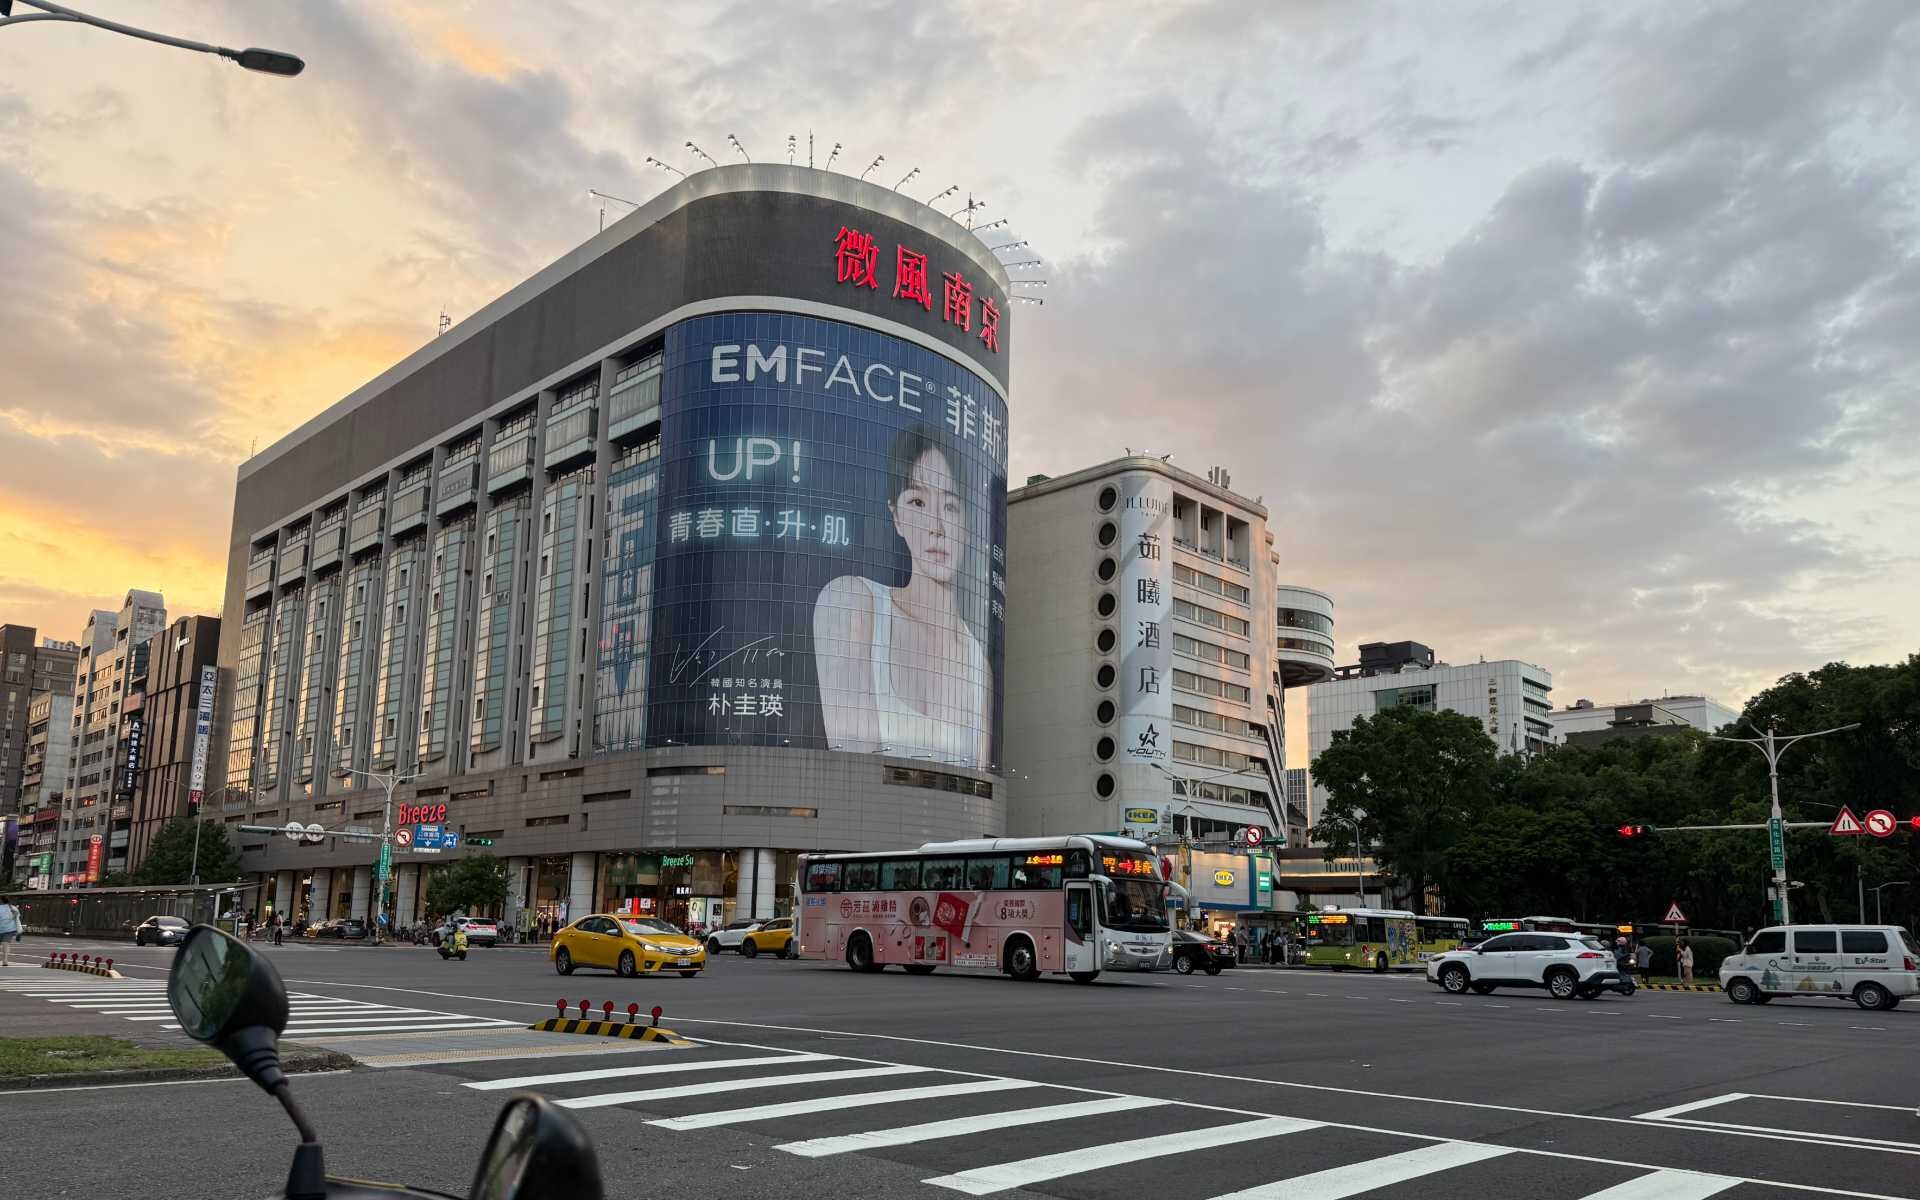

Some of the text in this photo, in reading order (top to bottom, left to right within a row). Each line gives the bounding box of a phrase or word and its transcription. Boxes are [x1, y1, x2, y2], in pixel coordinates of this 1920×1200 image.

[834, 226, 1000, 352] 微風南京
[708, 438, 801, 483] UP!
[1137, 532, 1160, 695] 茹曦酒店
[710, 677, 783, 689] 韓國知名演員
[708, 692, 784, 717] 朴圭瑛
[1127, 747, 1167, 757] YOUTH
[398, 801, 447, 825] Breeze
[662, 855, 685, 867] Breeze
